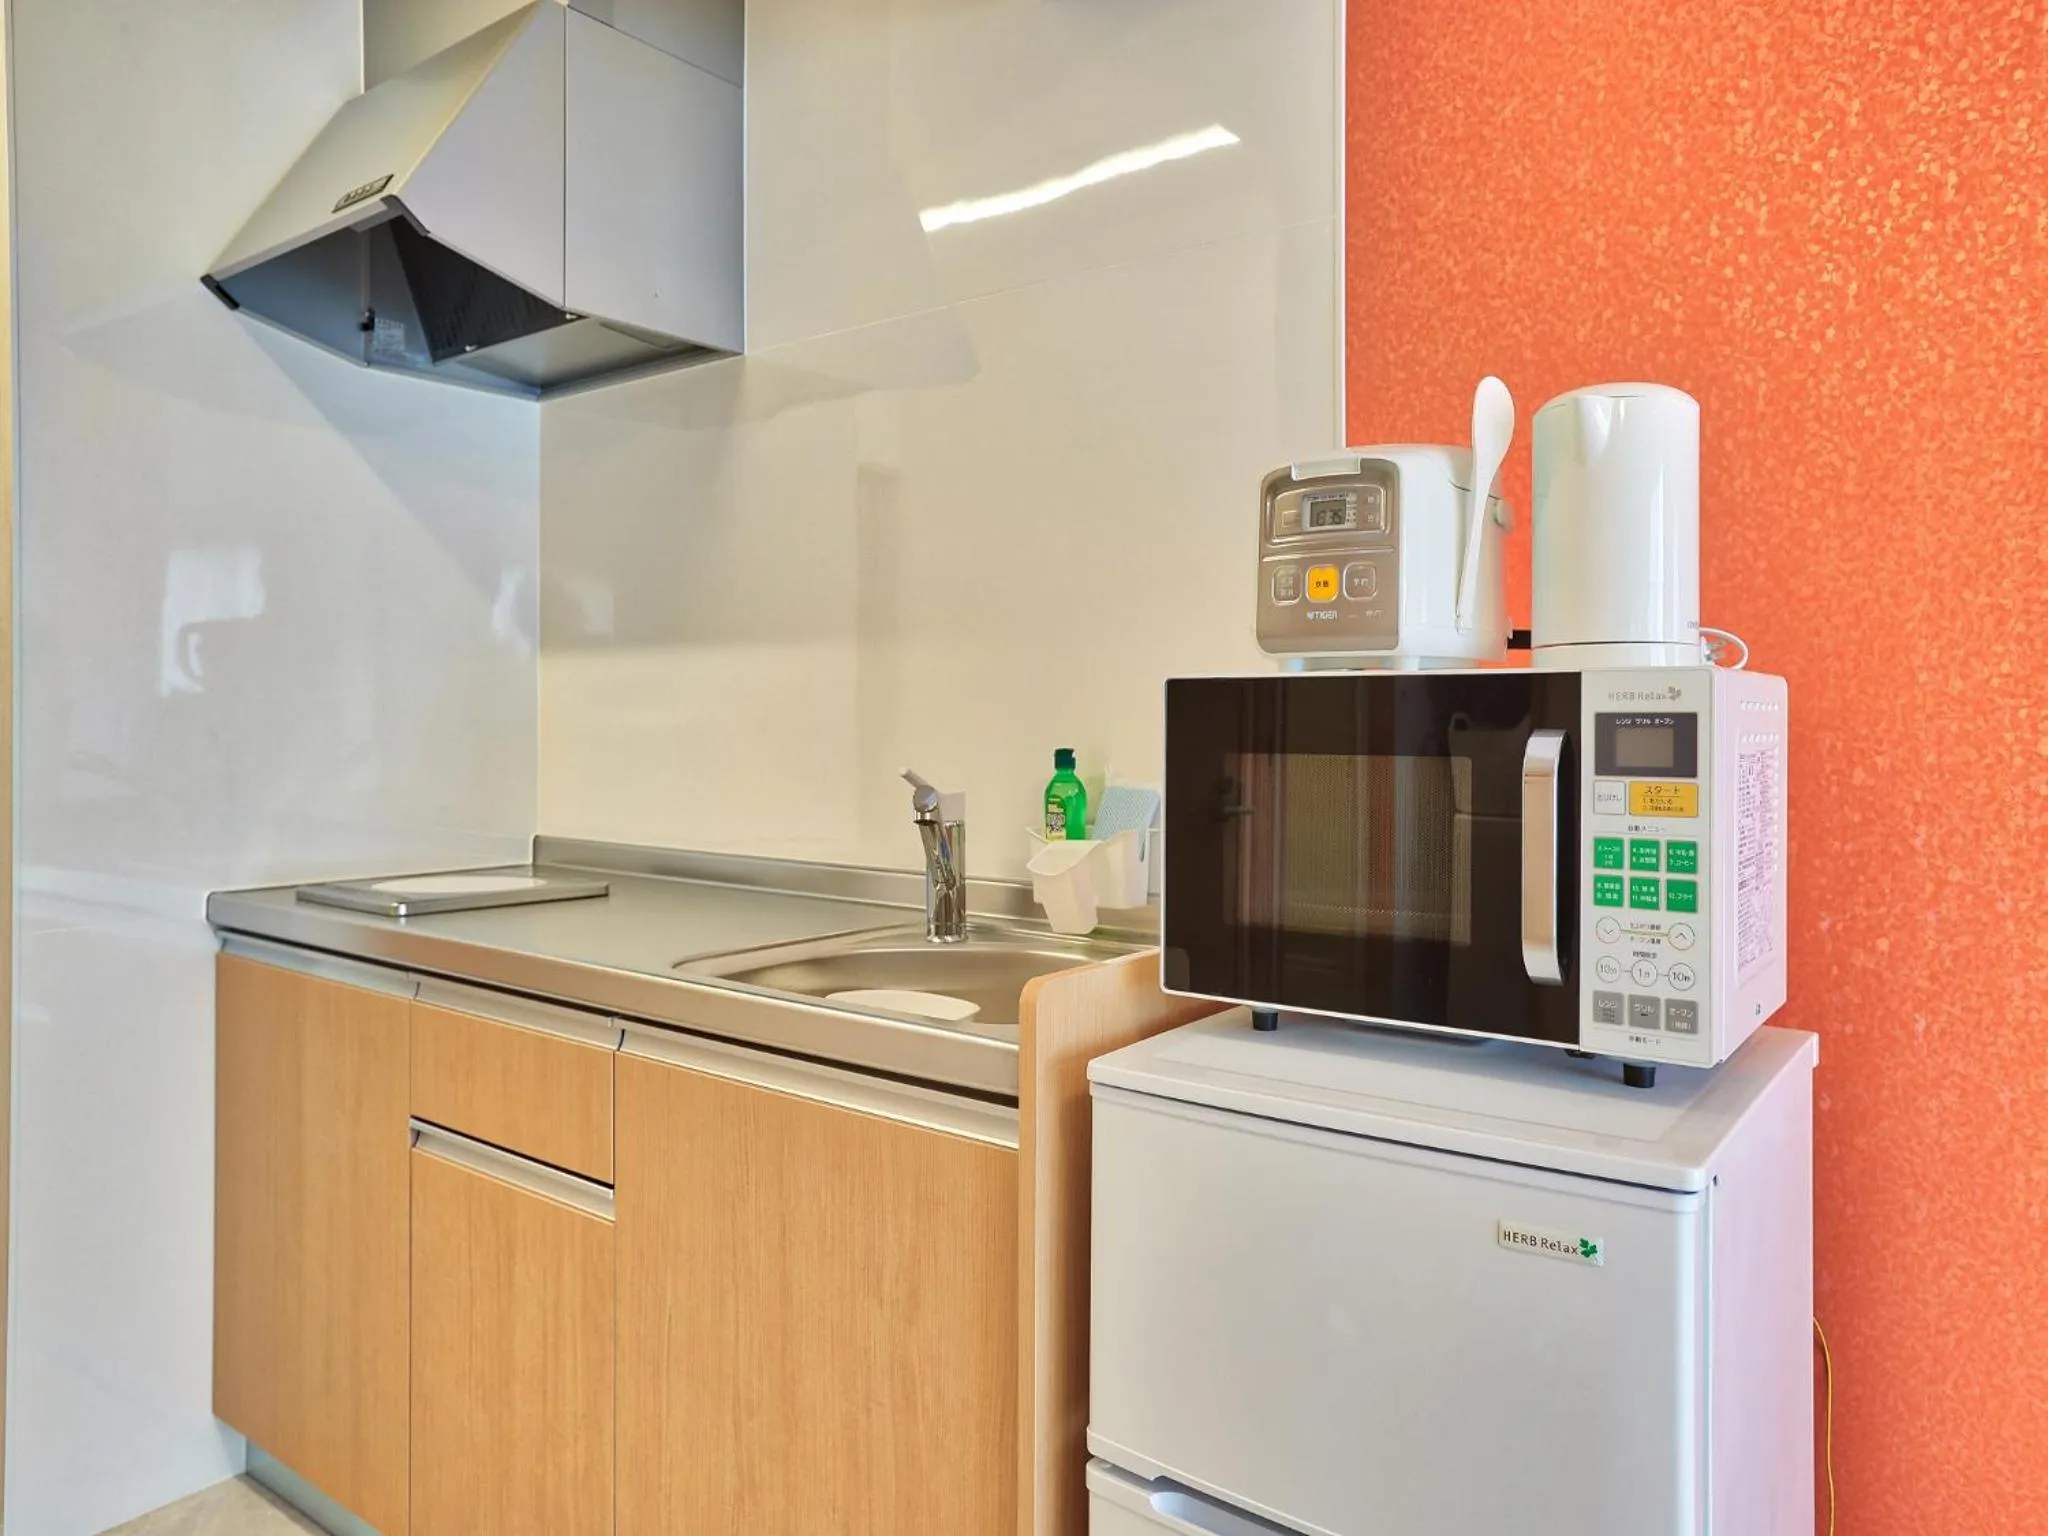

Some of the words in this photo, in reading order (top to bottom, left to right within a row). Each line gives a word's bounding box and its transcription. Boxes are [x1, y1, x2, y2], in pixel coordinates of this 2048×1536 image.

[1608, 691, 1636, 701] HERB
[1637, 691, 1667, 701] Relax
[1615, 717, 1632, 725] レンジ
[1644, 785, 1680, 795] スタート
[1503, 1230, 1538, 1247] HERB
[1540, 1237, 1579, 1255] Relax
